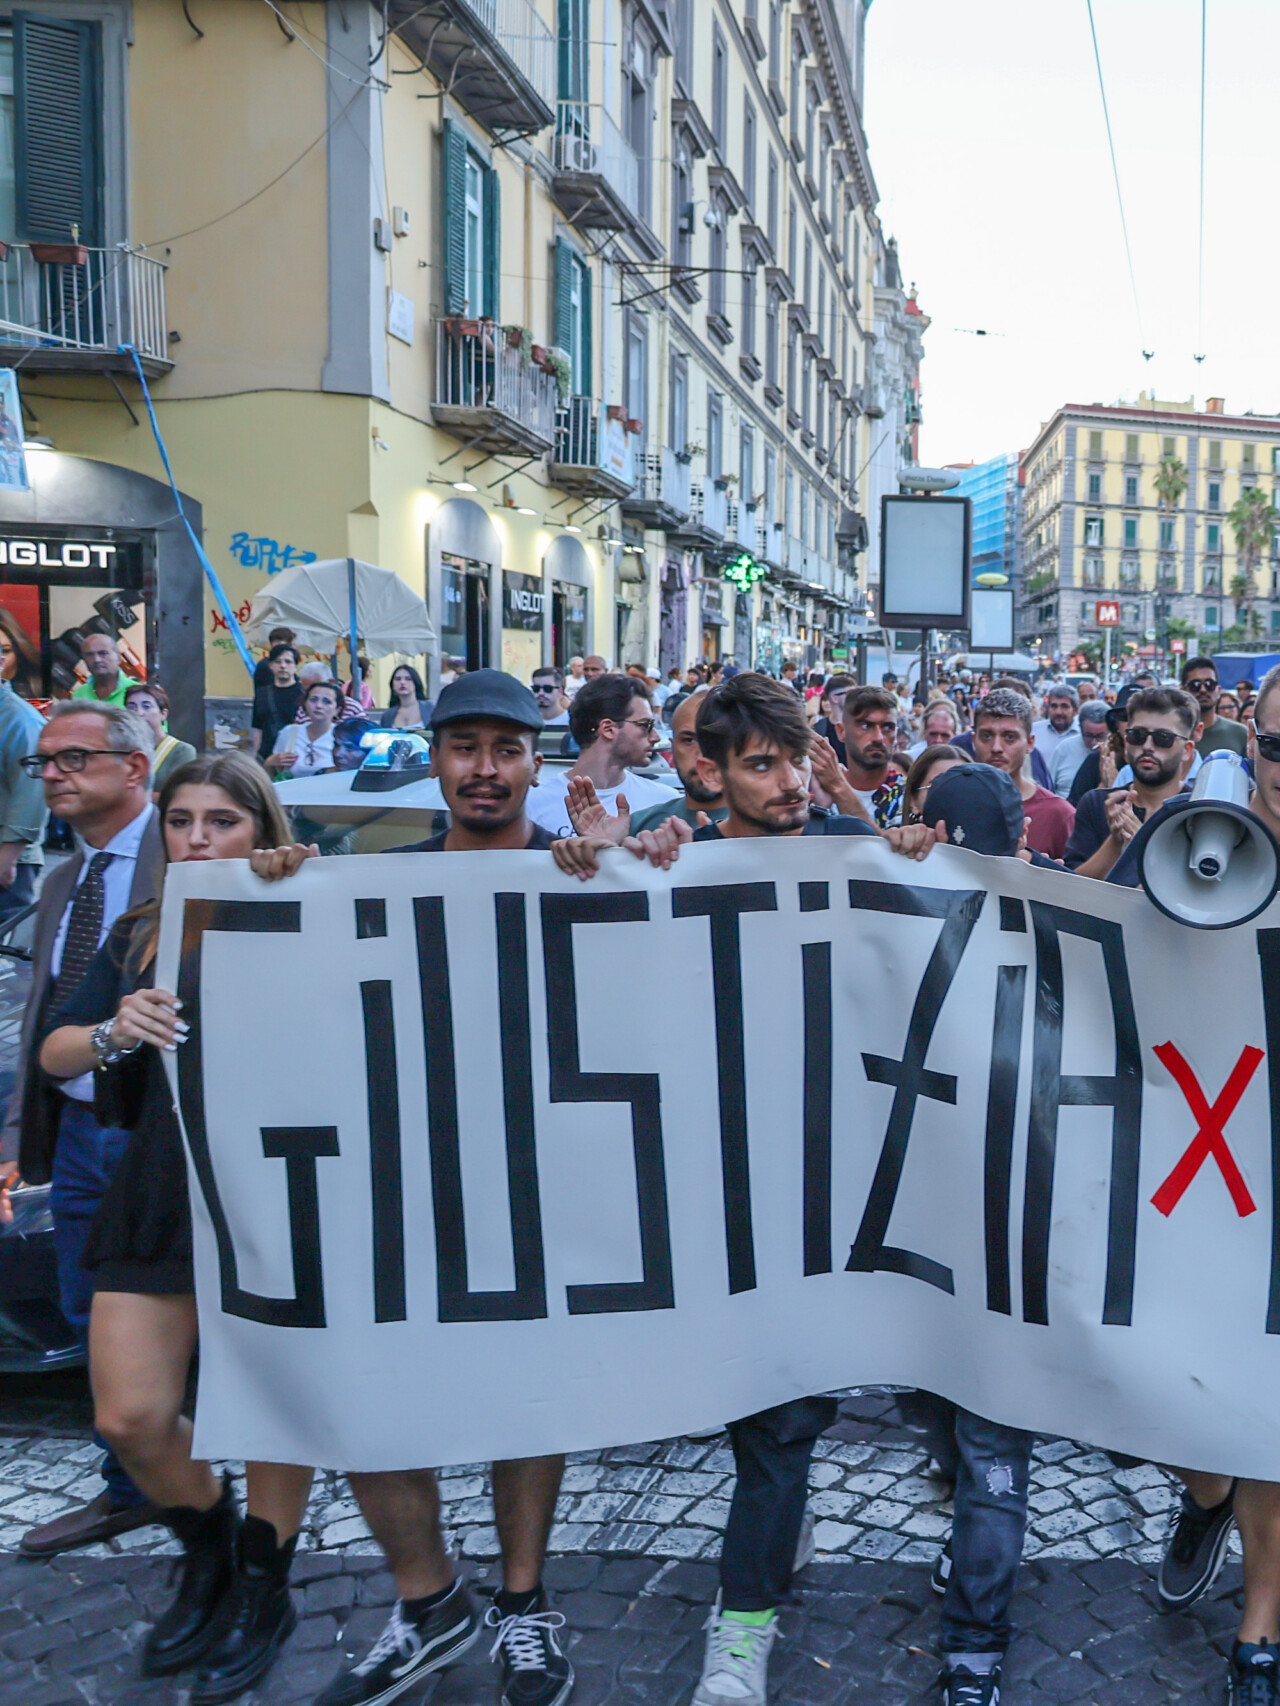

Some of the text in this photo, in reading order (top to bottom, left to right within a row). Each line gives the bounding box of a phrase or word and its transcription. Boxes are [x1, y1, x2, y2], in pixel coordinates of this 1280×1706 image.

[111, 597, 136, 624] KISS
[511, 589, 546, 613] INGLOT
[1100, 605, 1117, 621] M
